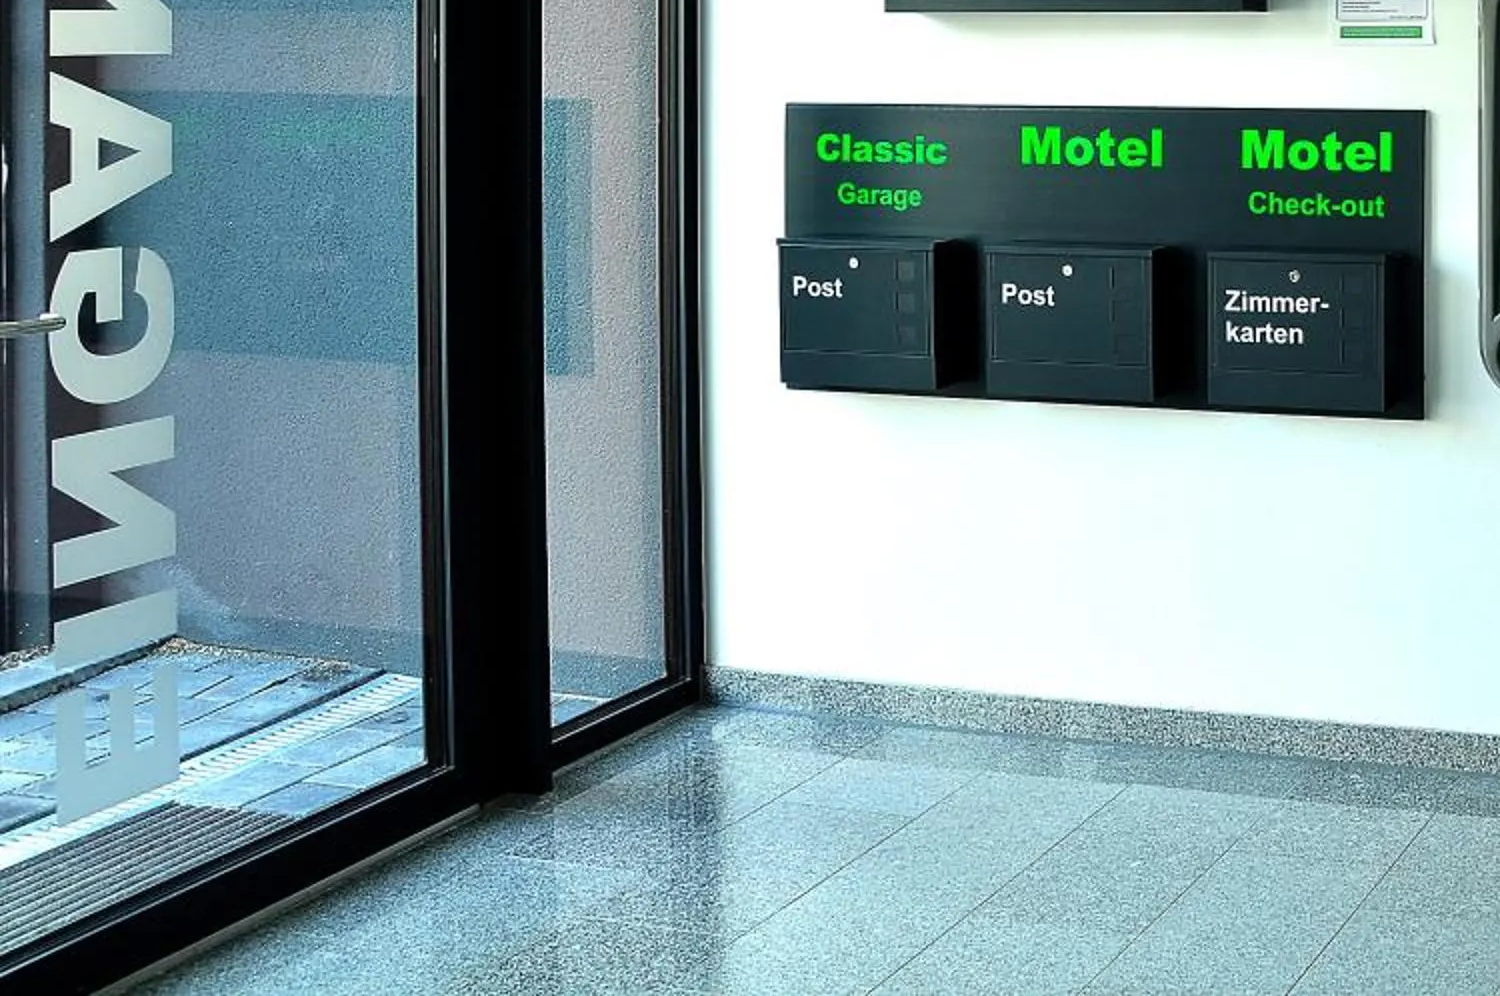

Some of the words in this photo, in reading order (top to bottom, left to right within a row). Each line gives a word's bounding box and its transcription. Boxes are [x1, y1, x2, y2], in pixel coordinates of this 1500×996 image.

[815, 132, 949, 166] Classic
[1019, 125, 1164, 168] Motel
[1240, 129, 1393, 172] Motel
[836, 182, 922, 210] Garage
[1247, 191, 1385, 218] Check-out
[792, 275, 843, 299] Post
[1001, 283, 1055, 307] Post
[1224, 289, 1330, 314] Zimmer-
[1225, 320, 1304, 345] karten
